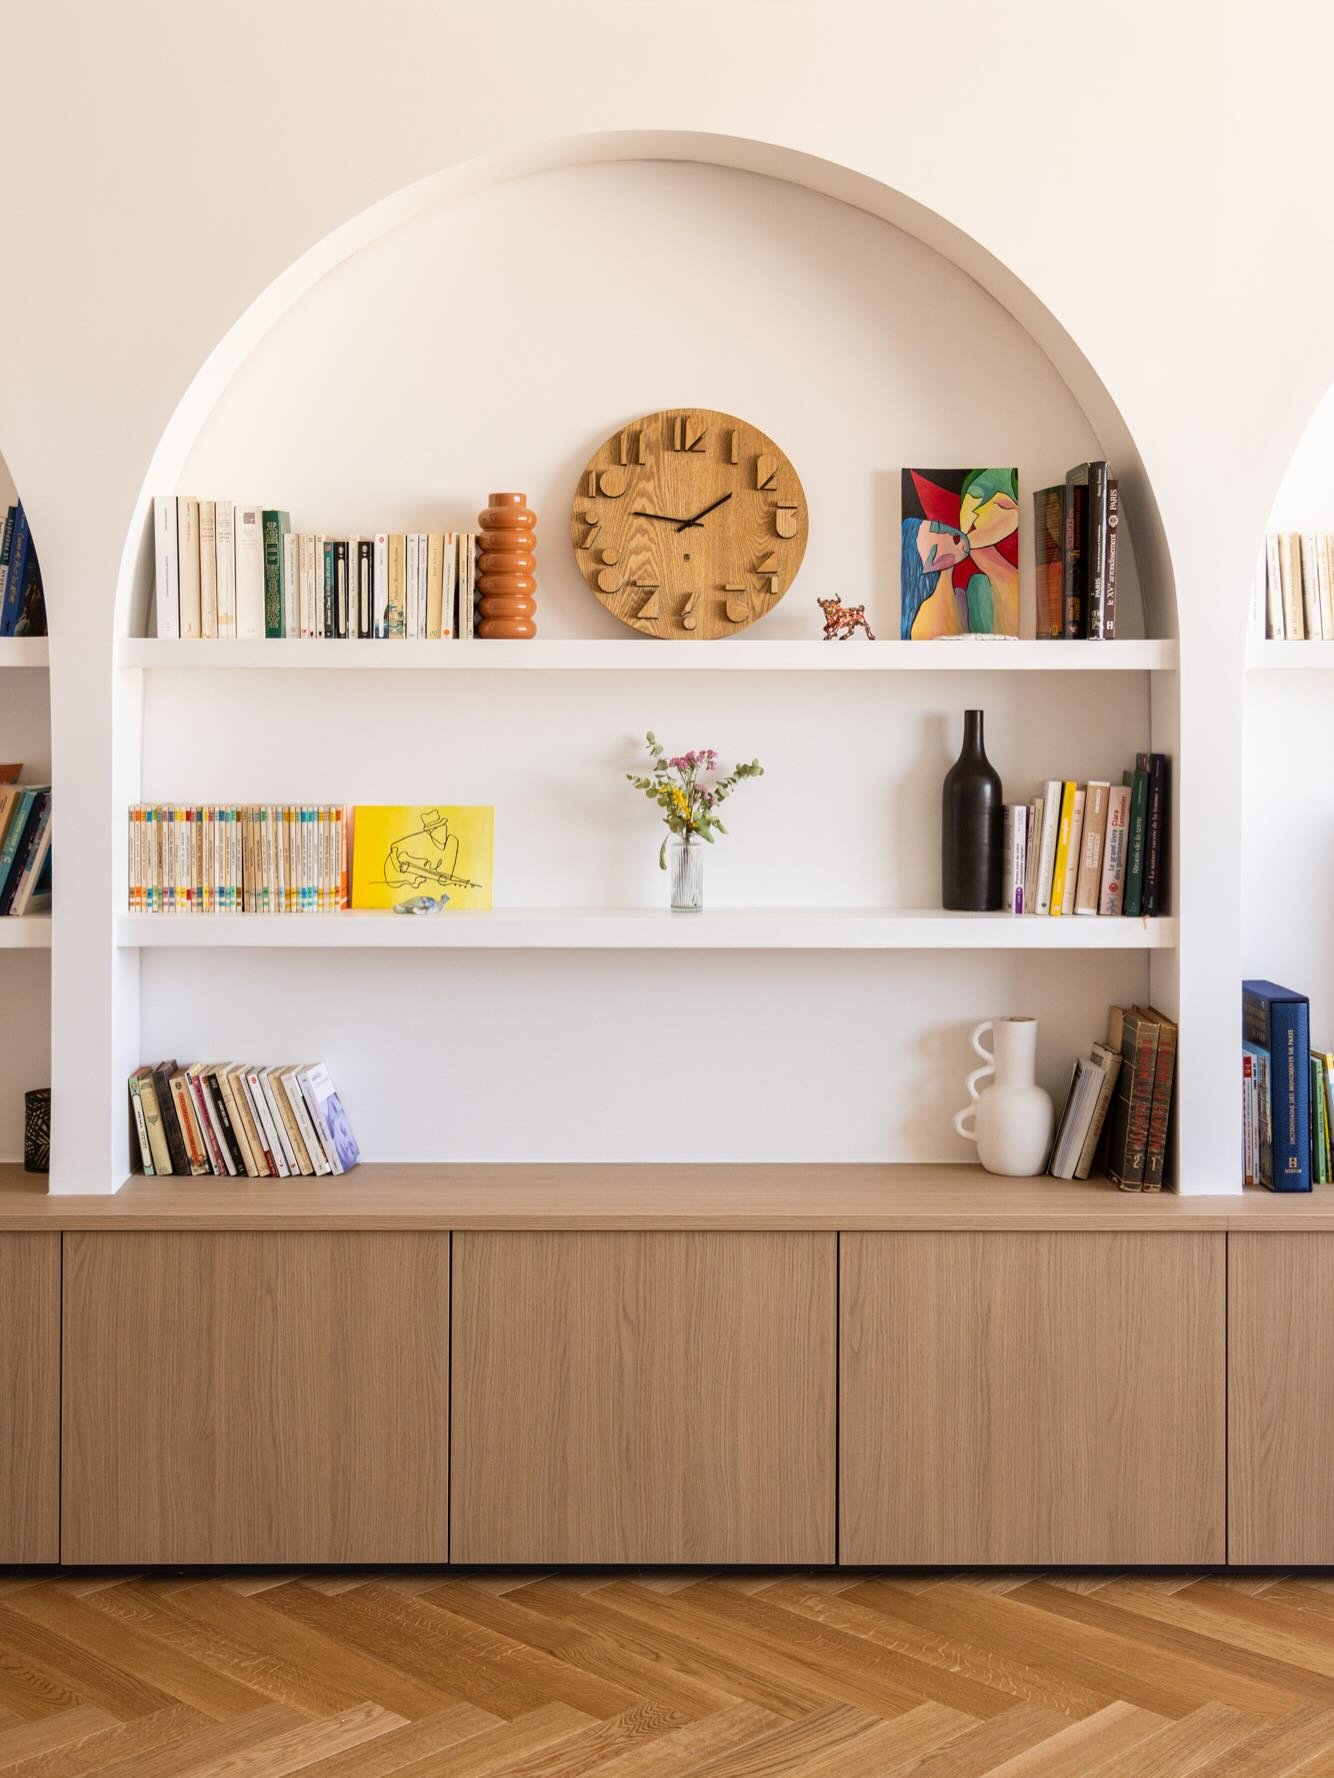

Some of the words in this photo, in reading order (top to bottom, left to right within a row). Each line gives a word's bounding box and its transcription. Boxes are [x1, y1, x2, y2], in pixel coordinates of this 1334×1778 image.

[619, 430, 645, 465] 11
[672, 416, 706, 452] 12
[730, 430, 738, 465] 1
[588, 470, 627, 498] 10
[756, 454, 780, 491] 2
[1109, 489, 1118, 511] PARIS
[582, 511, 602, 550] 9
[775, 503, 798, 539] 3
[597, 549, 623, 593] 8
[755, 551, 779, 594] 4
[635, 580, 660, 619] 7
[681, 592, 701, 631] 6
[725, 583, 749, 623] 5
[1109, 843, 1118, 863] grand
[1133, 1155, 1140, 1169] 2
[1151, 1157, 1156, 1171] 1
